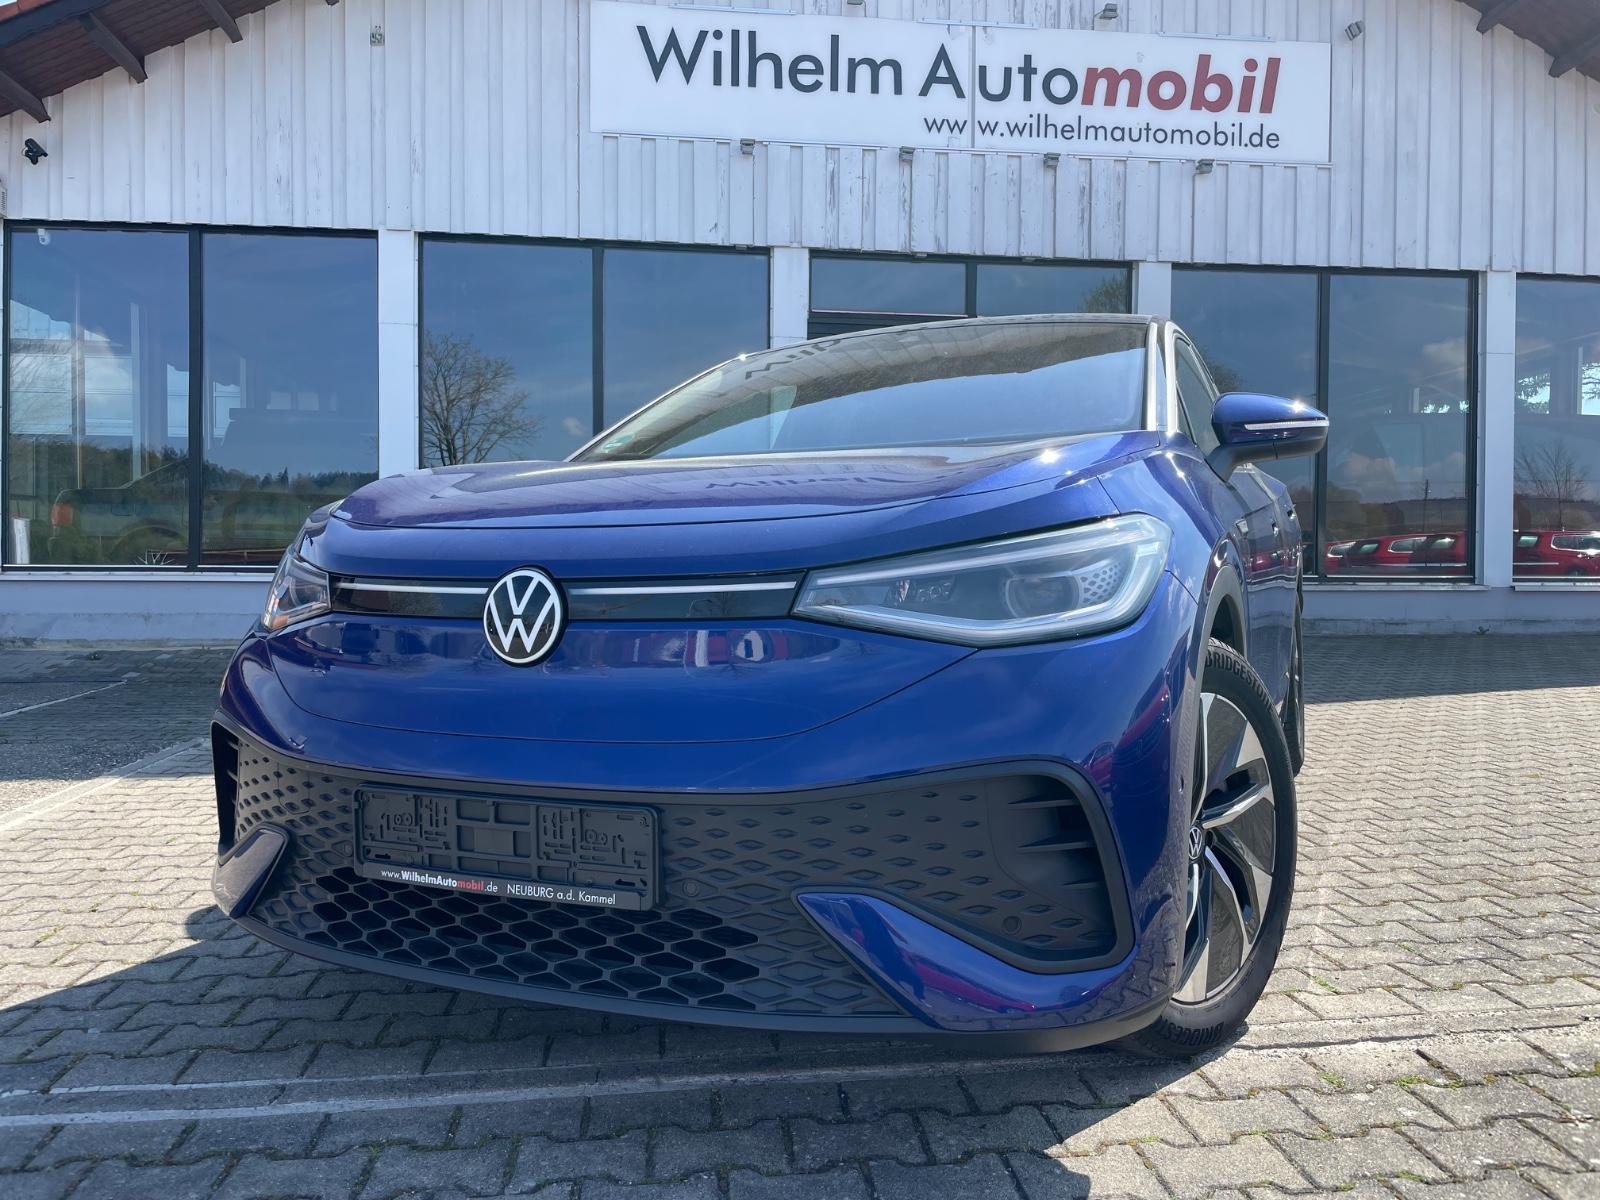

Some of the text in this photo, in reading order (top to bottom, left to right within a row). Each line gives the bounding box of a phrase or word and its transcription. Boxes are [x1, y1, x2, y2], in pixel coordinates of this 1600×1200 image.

[636, 25, 903, 96] Wilhelm
[923, 112, 1280, 149] www.wilhelmautomobil.de
[380, 869, 616, 905] www.WilhelmAutomobil.de NEUBURG a.d. Kammel
